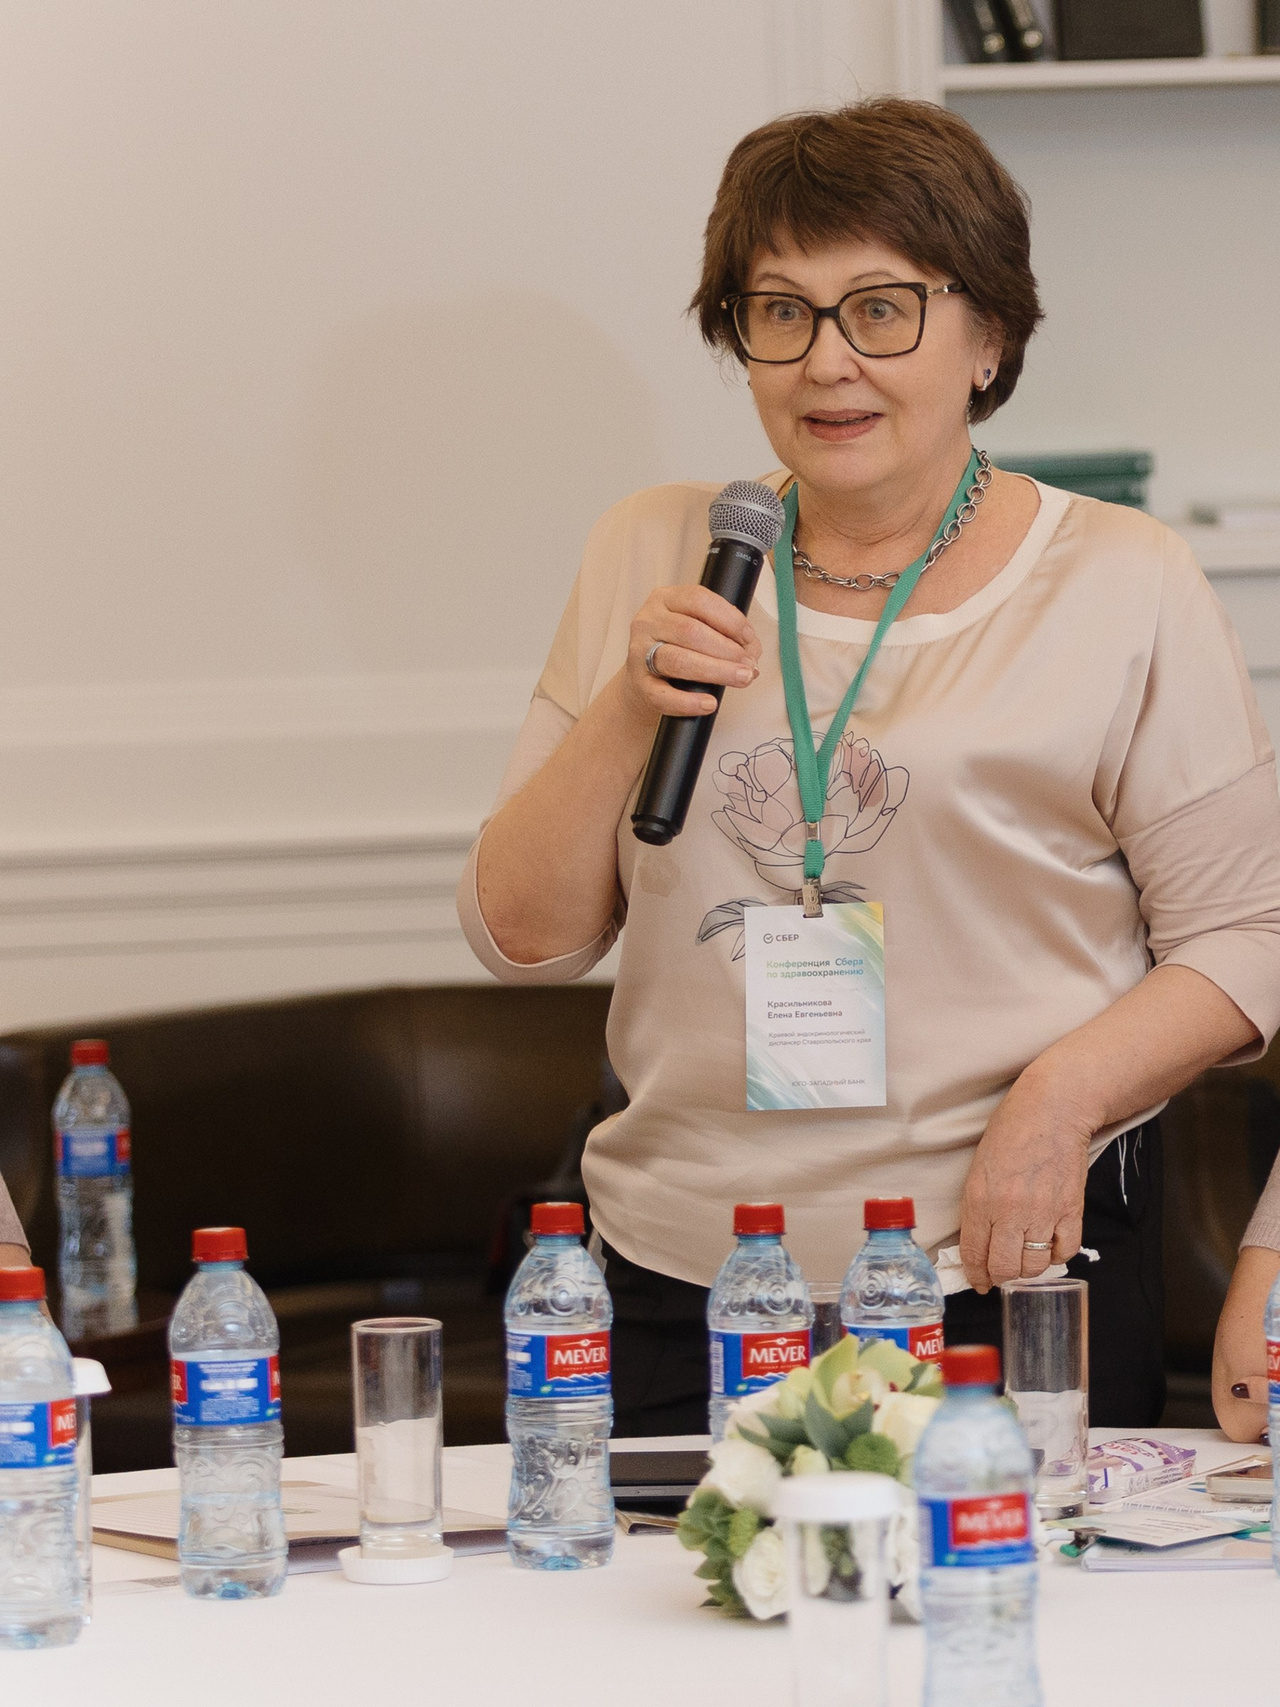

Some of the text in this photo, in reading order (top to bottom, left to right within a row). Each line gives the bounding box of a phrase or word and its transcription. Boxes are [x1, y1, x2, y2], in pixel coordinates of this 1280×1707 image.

[775, 934, 800, 942] СБЕР
[766, 957, 864, 969] Конференция Сбера
[780, 968, 864, 979] здравоохранению
[767, 999, 833, 1009] Красильникова
[767, 1010, 843, 1019] Елена Евгеньевна
[553, 1346, 608, 1366] MEVER
[748, 1345, 807, 1364] MEVER
